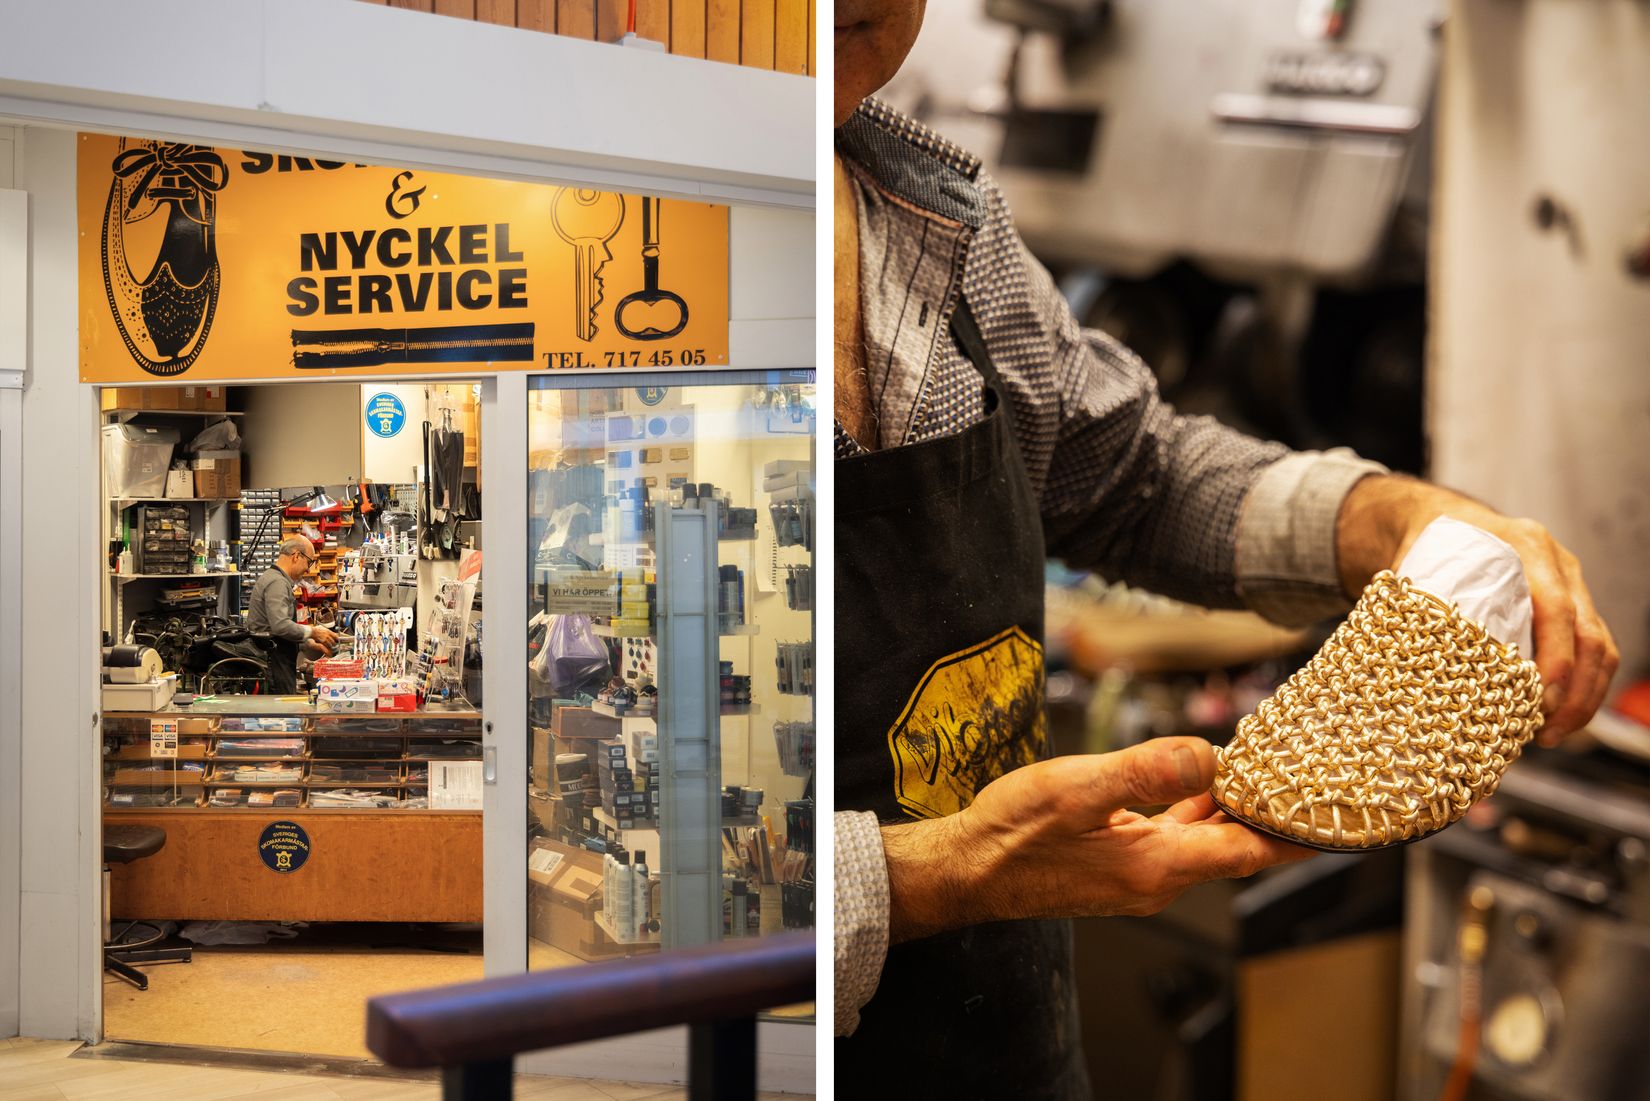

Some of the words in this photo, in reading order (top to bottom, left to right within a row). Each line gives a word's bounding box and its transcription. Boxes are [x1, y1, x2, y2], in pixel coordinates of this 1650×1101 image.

[384, 170, 427, 220] &
[300, 223, 524, 272] NYCKEL
[285, 268, 529, 317] SERVICE
[542, 351, 596, 369] TEL.
[603, 350, 641, 368] 717
[647, 349, 673, 367] 45
[680, 349, 706, 366] 05
